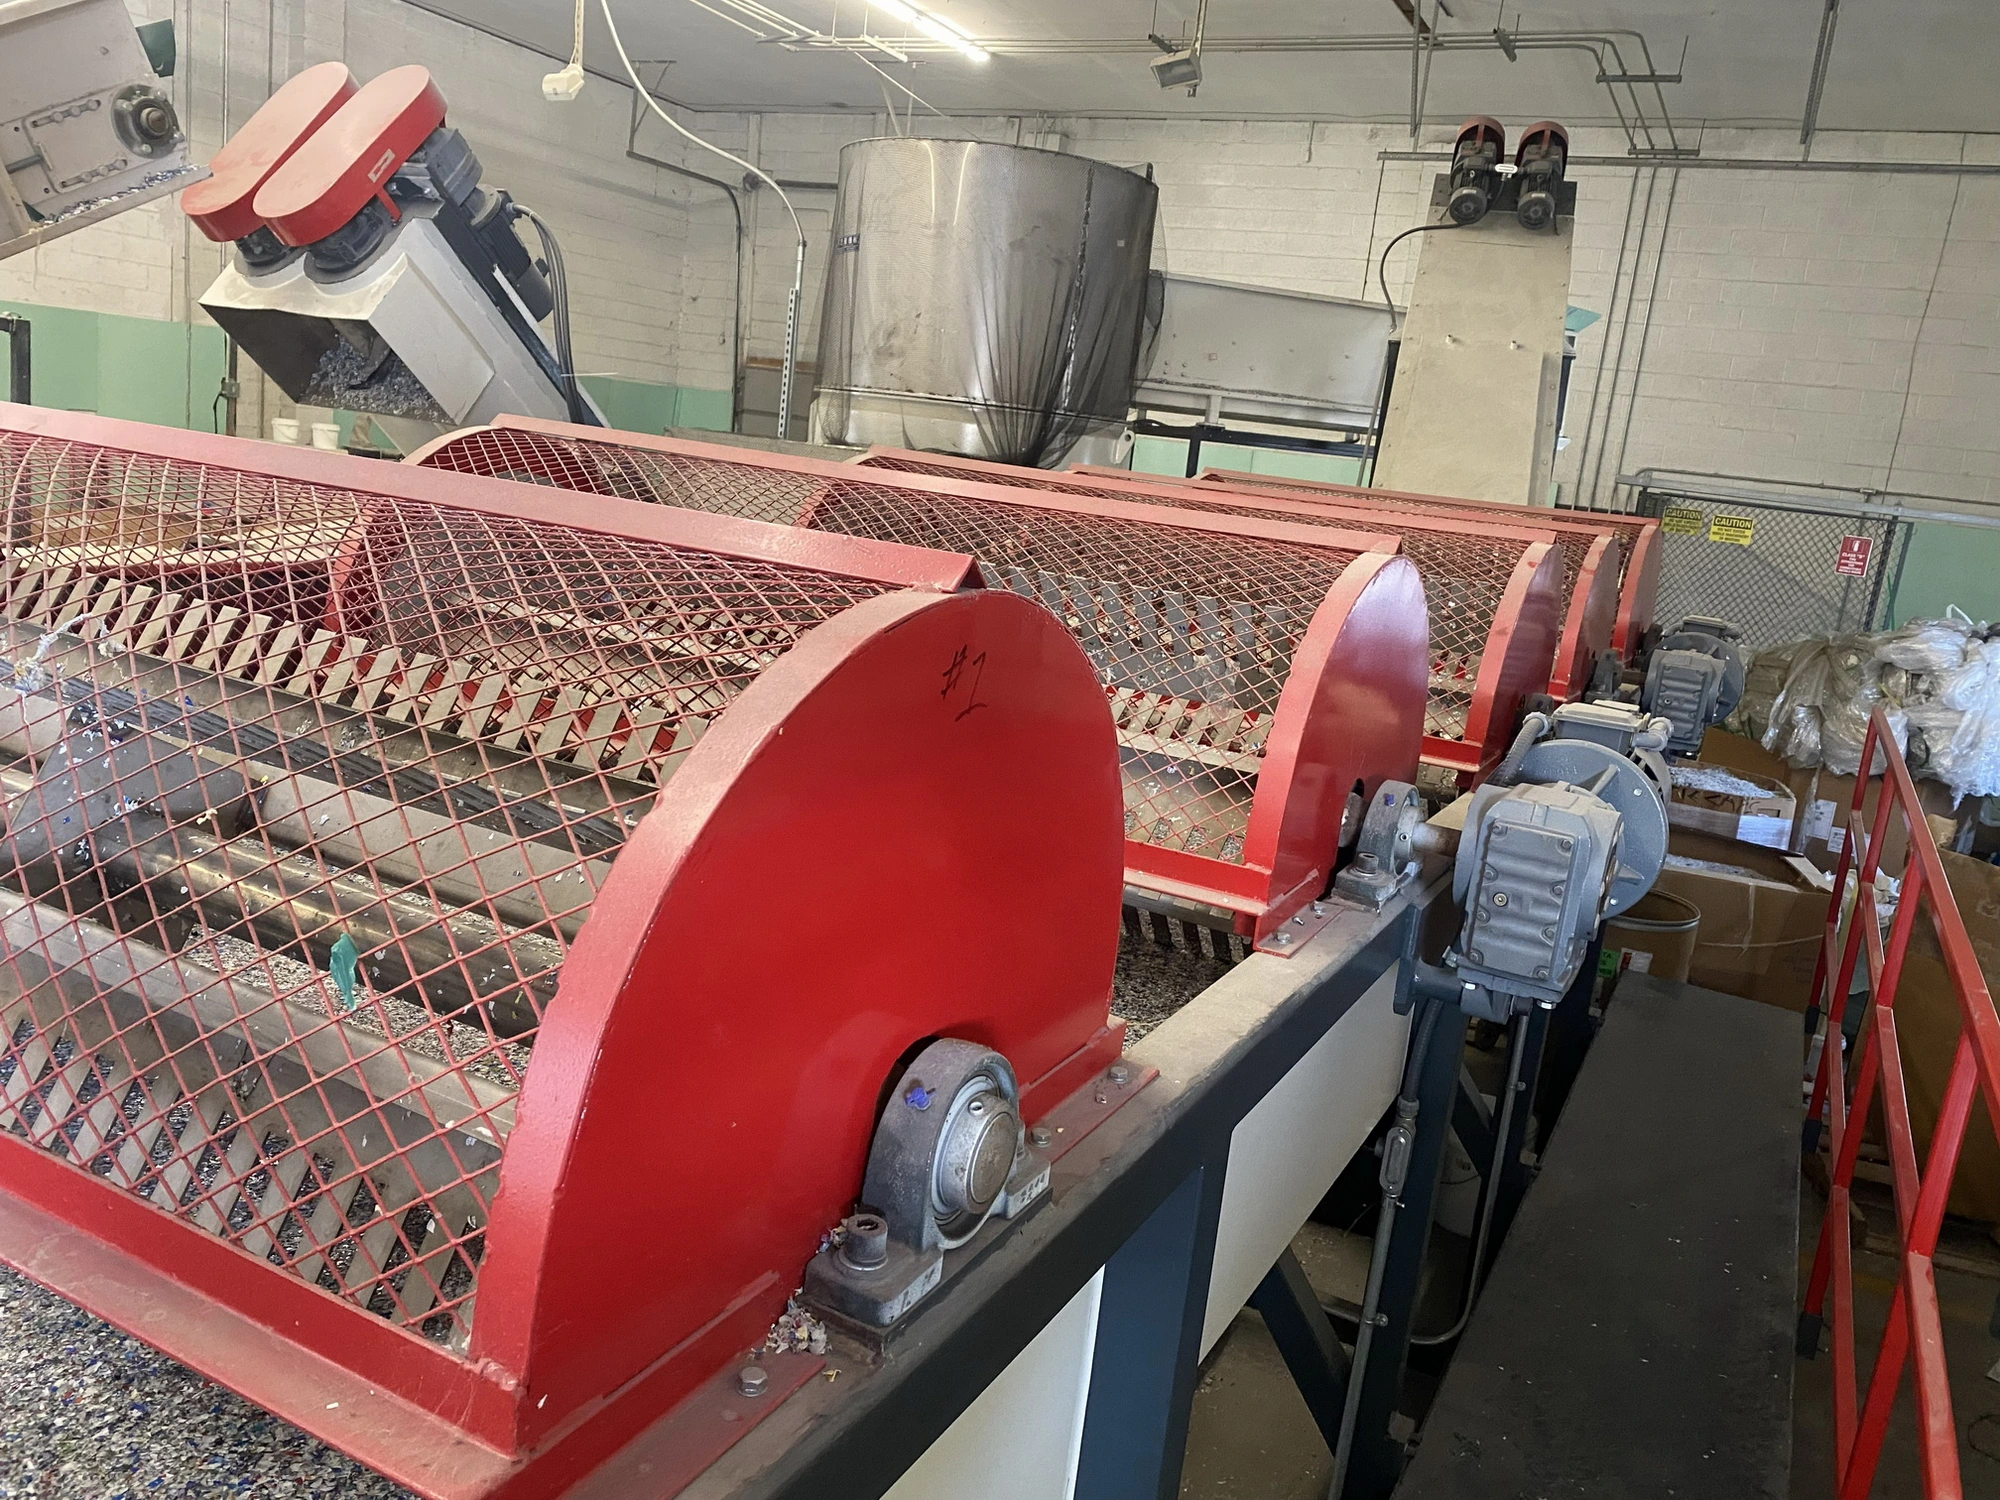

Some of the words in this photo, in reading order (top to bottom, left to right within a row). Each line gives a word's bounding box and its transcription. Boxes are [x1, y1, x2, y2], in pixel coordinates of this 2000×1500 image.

[1666, 508, 1701, 520] CAUTION
[1715, 517, 1751, 529] CAUTION
[941, 644, 988, 722] #1
